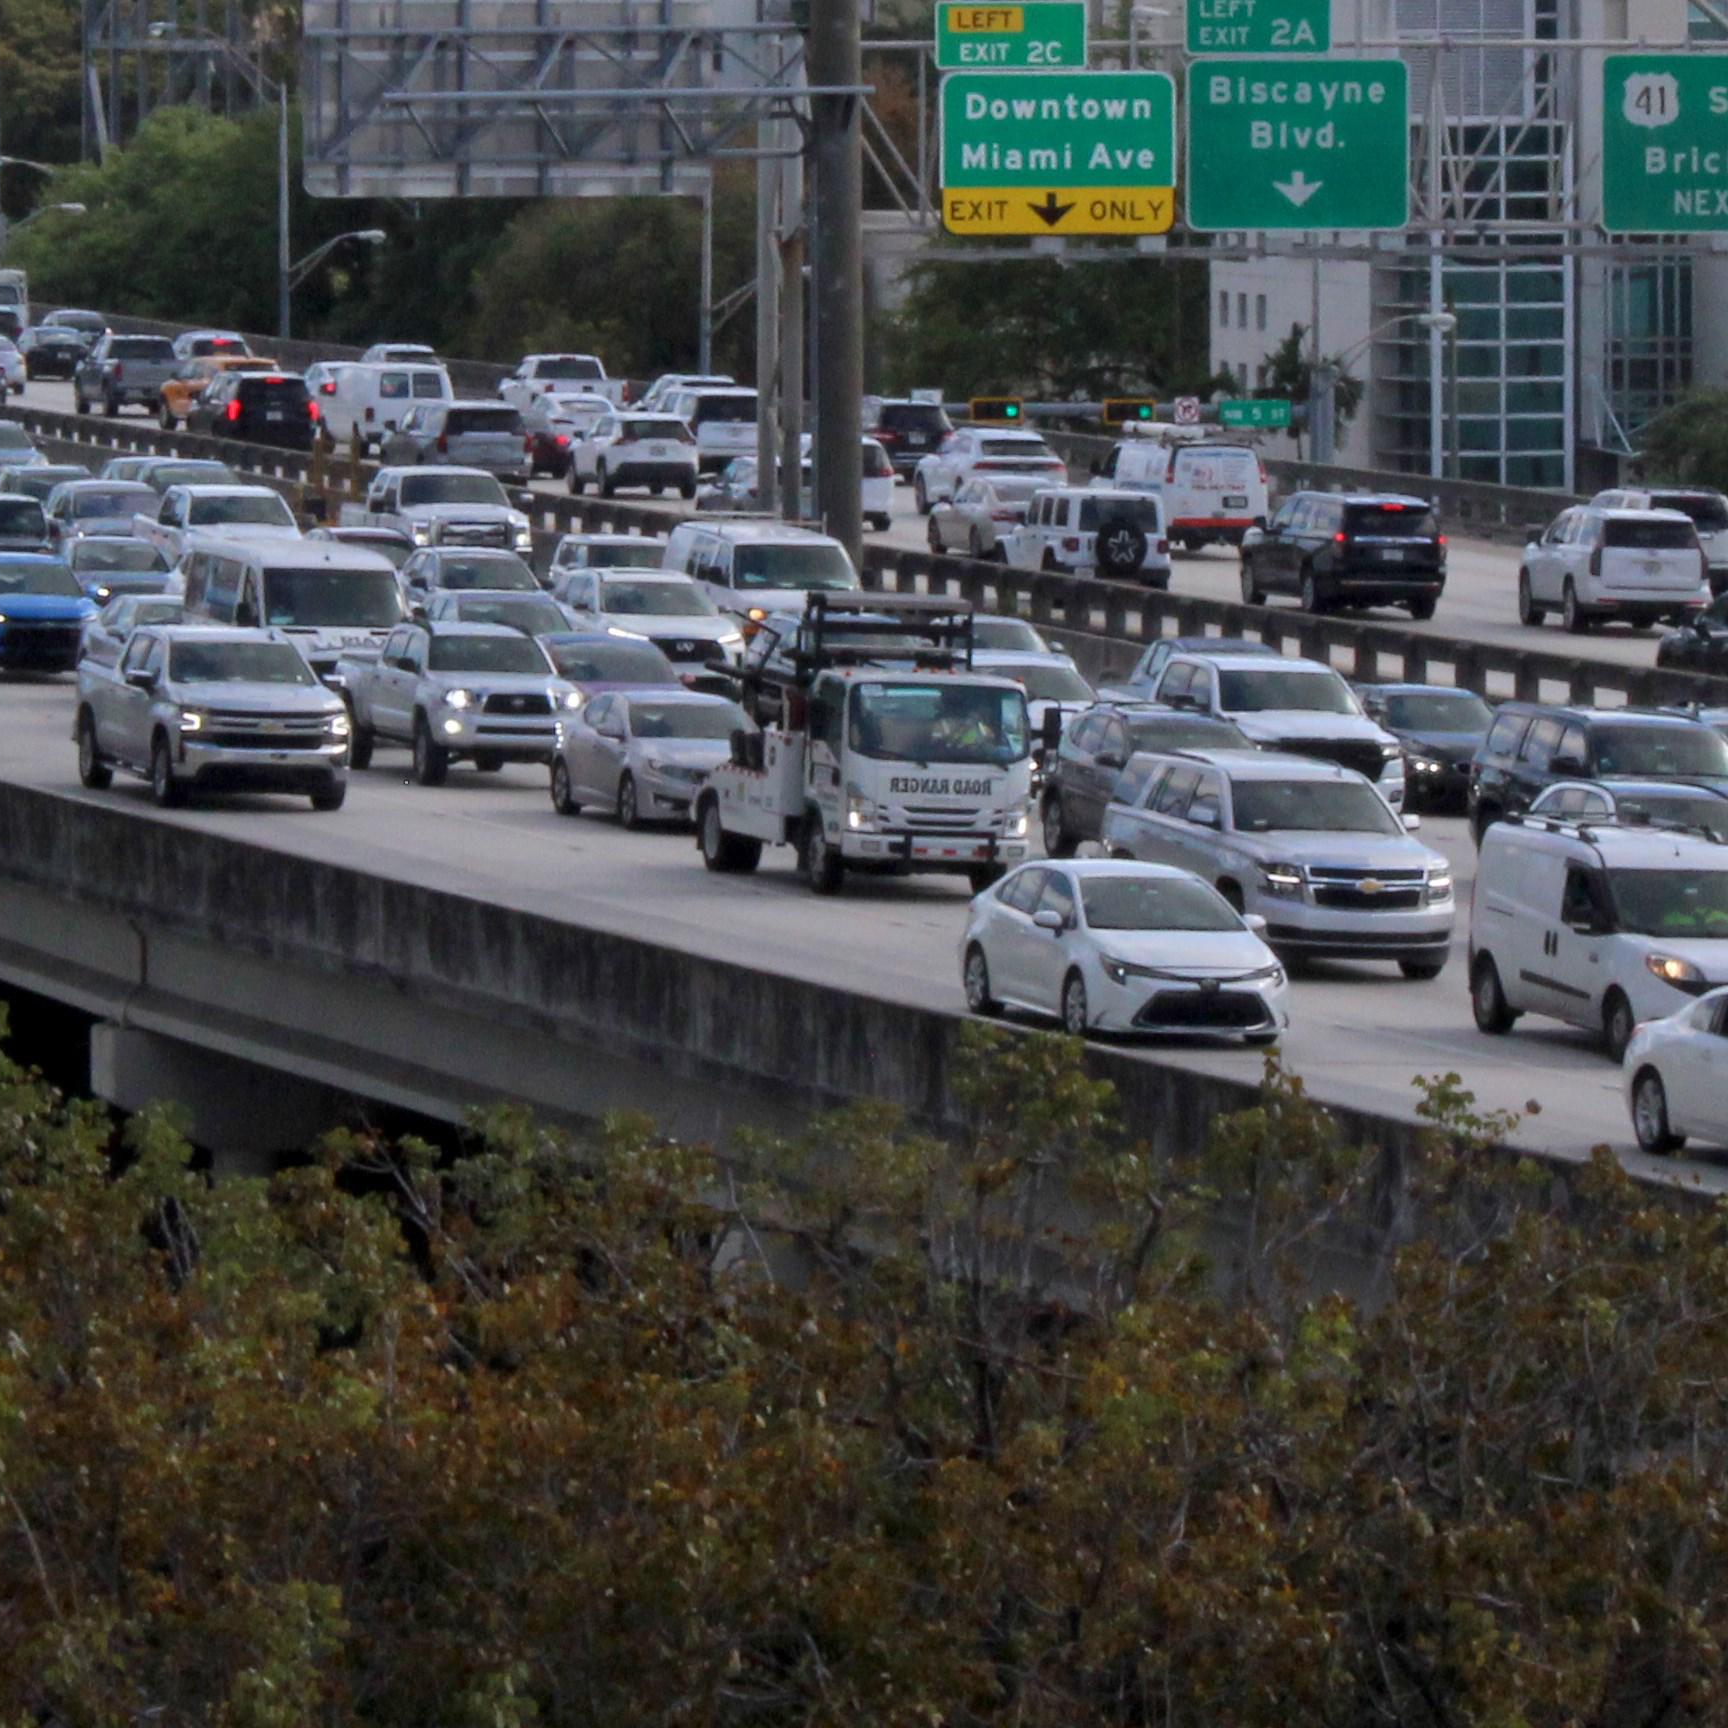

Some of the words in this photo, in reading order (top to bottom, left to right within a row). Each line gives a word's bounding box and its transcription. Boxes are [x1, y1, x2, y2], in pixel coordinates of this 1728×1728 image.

[956, 10, 1012, 29] LEFT
[1199, 0, 1256, 19] LEFT
[1199, 26, 1251, 45] EXIT
[1270, 19, 1316, 46] 2A
[959, 42, 1010, 62] EXIT
[1027, 40, 1062, 63] 2C
[965, 92, 1152, 120] Downtown
[1209, 75, 1386, 111] Biscayne
[1635, 85, 1665, 115] 41
[1250, 120, 1345, 149] Blvd.
[961, 143, 1071, 170] Miami
[1088, 143, 1155, 170] Ave
[950, 200, 1008, 221] EXIT
[1090, 200, 1164, 221] ONLY
